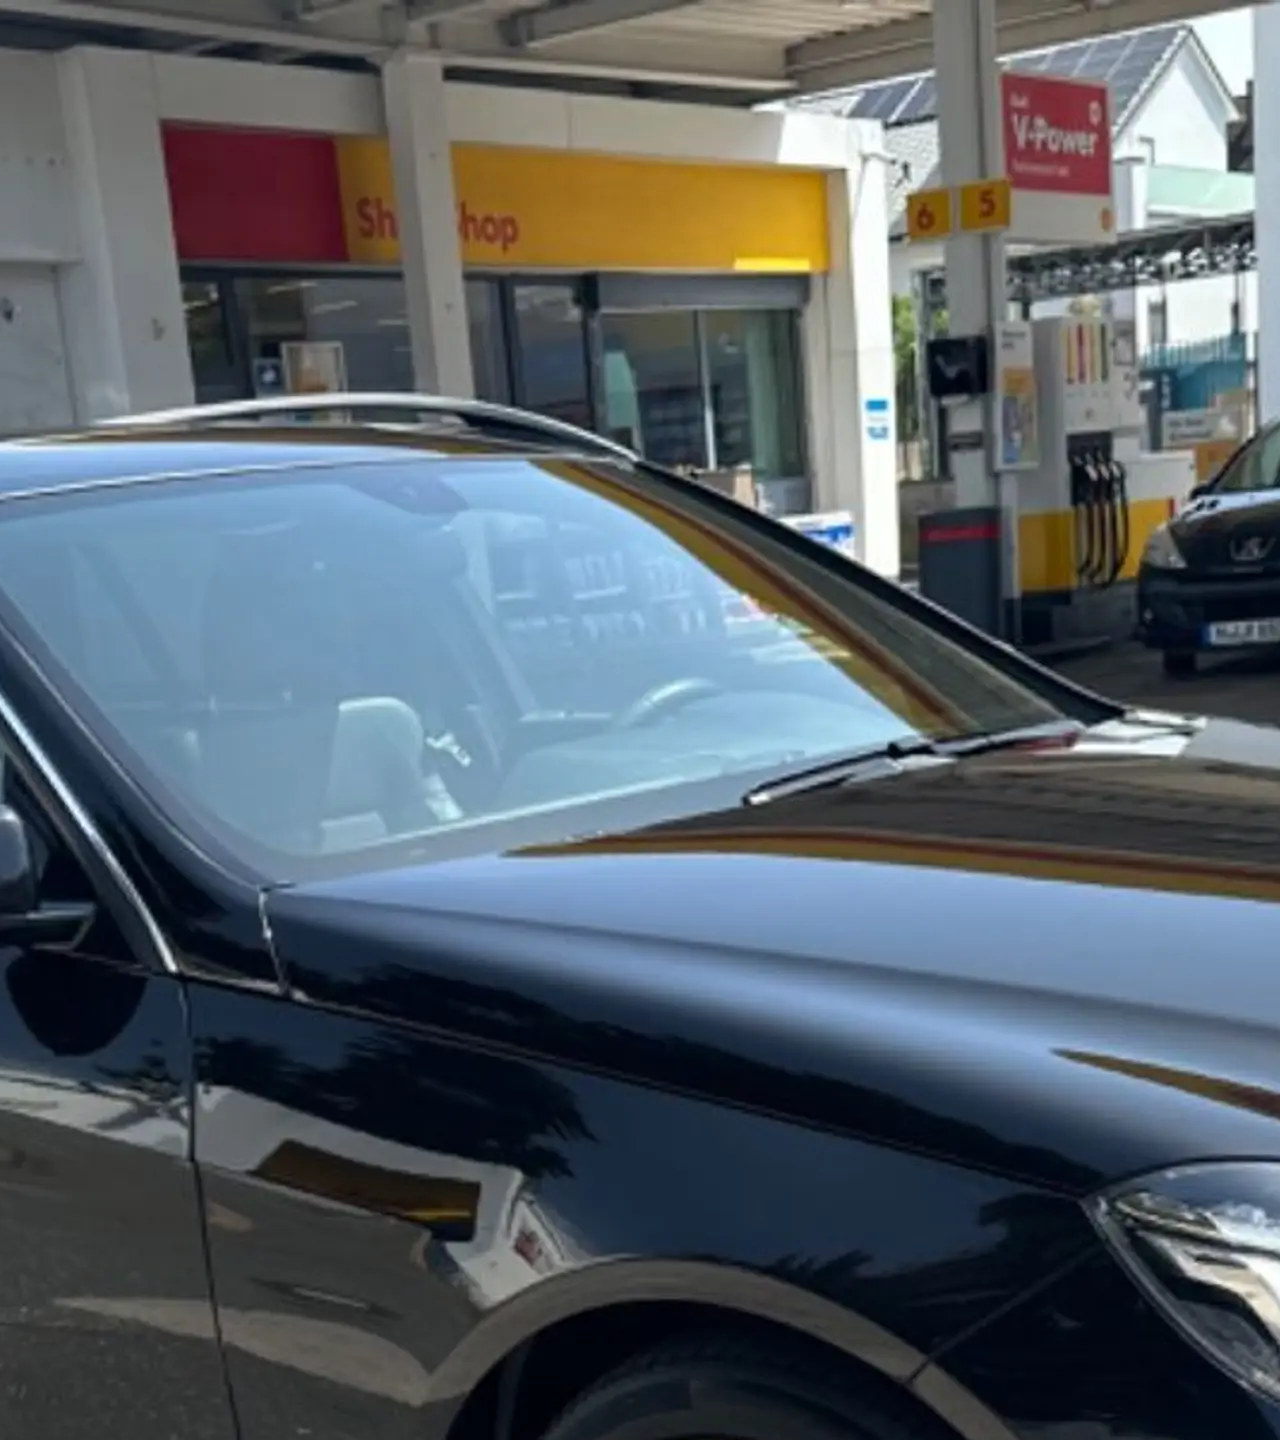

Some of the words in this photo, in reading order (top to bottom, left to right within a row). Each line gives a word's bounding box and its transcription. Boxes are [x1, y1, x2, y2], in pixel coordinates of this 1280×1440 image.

[1011, 113, 1098, 157] V-Power
[916, 203, 936, 231] 6
[978, 190, 996, 218] 5
[459, 200, 518, 253] hop
